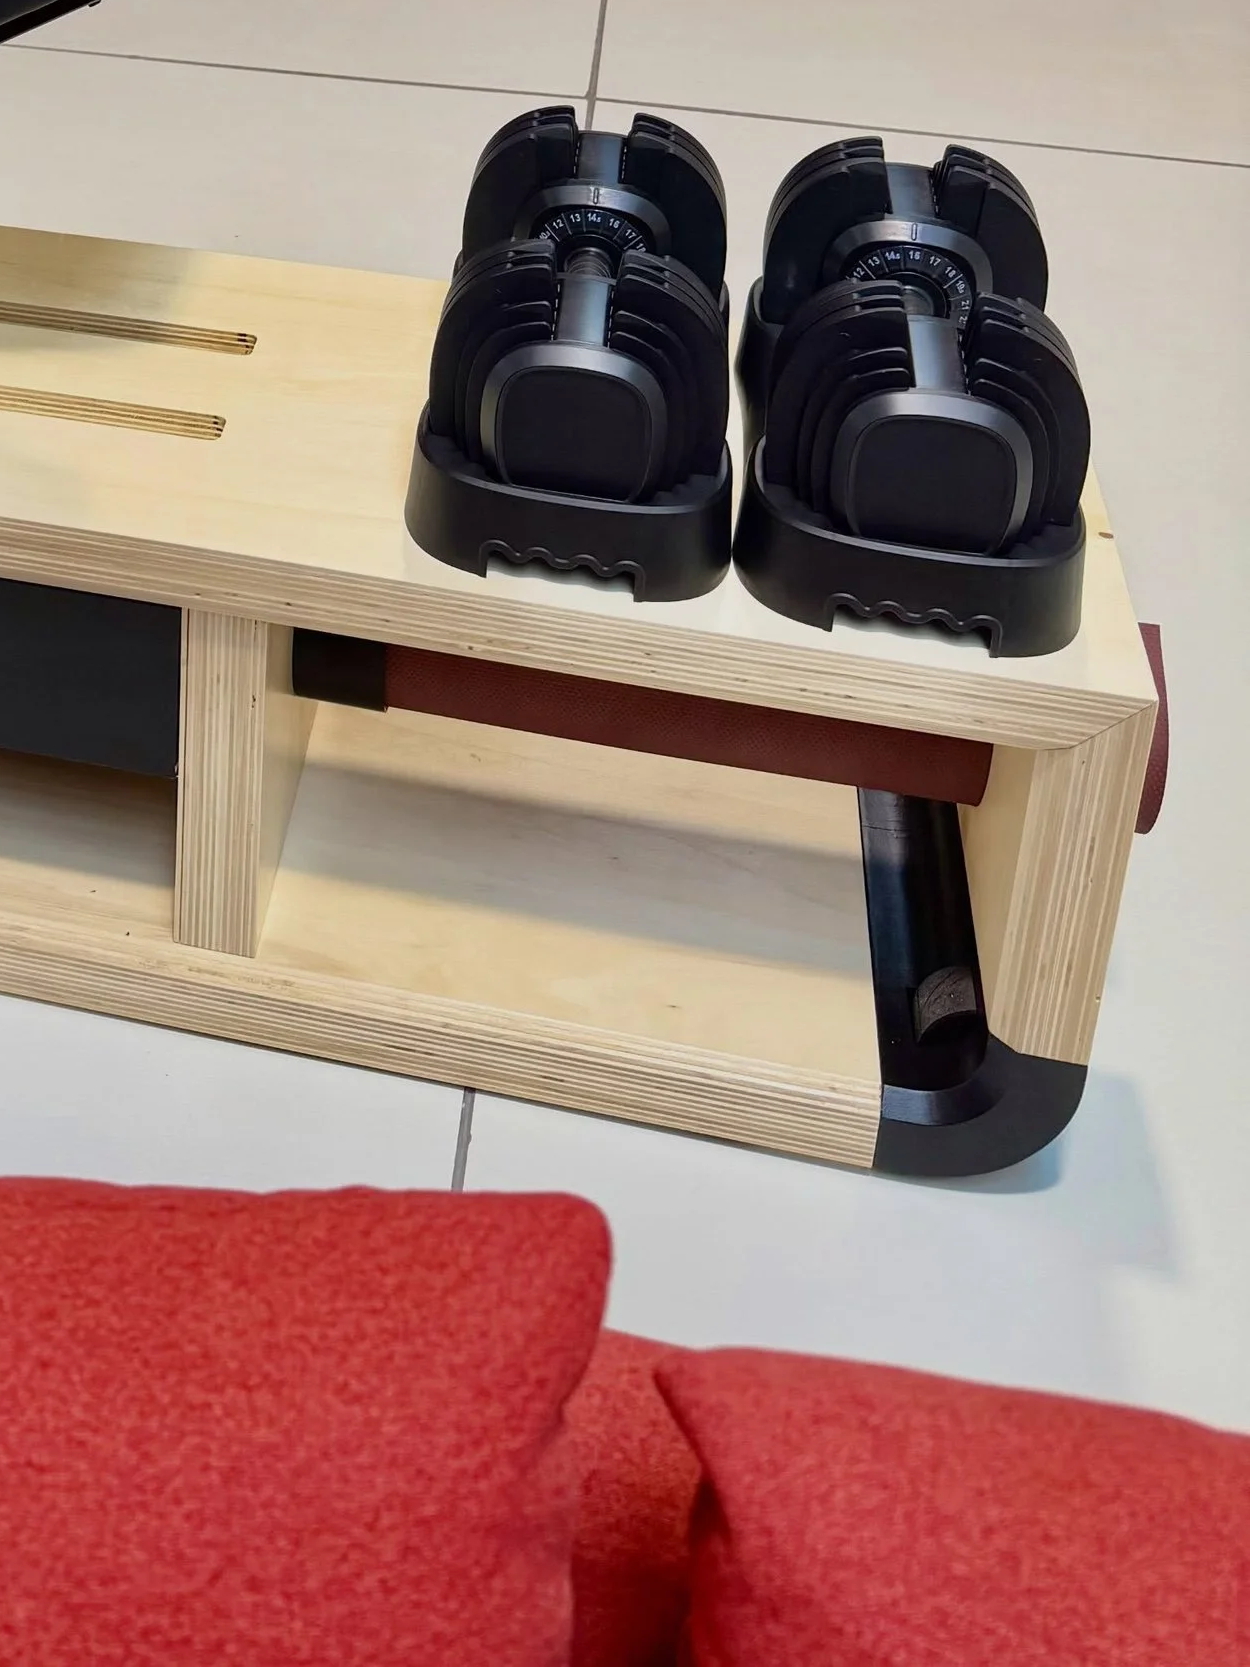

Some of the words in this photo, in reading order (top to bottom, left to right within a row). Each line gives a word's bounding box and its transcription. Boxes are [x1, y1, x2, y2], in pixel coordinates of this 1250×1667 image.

[553, 219, 565, 229] 12
[570, 213, 582, 223] 13
[609, 218, 621, 229] 16
[625, 229, 637, 239] 17
[853, 267, 865, 278] 12
[868, 256, 880, 267] 13
[909, 251, 921, 260] 16
[930, 256, 942, 267] 17
[945, 266, 956, 278] 18
[961, 299, 970, 310] 21
